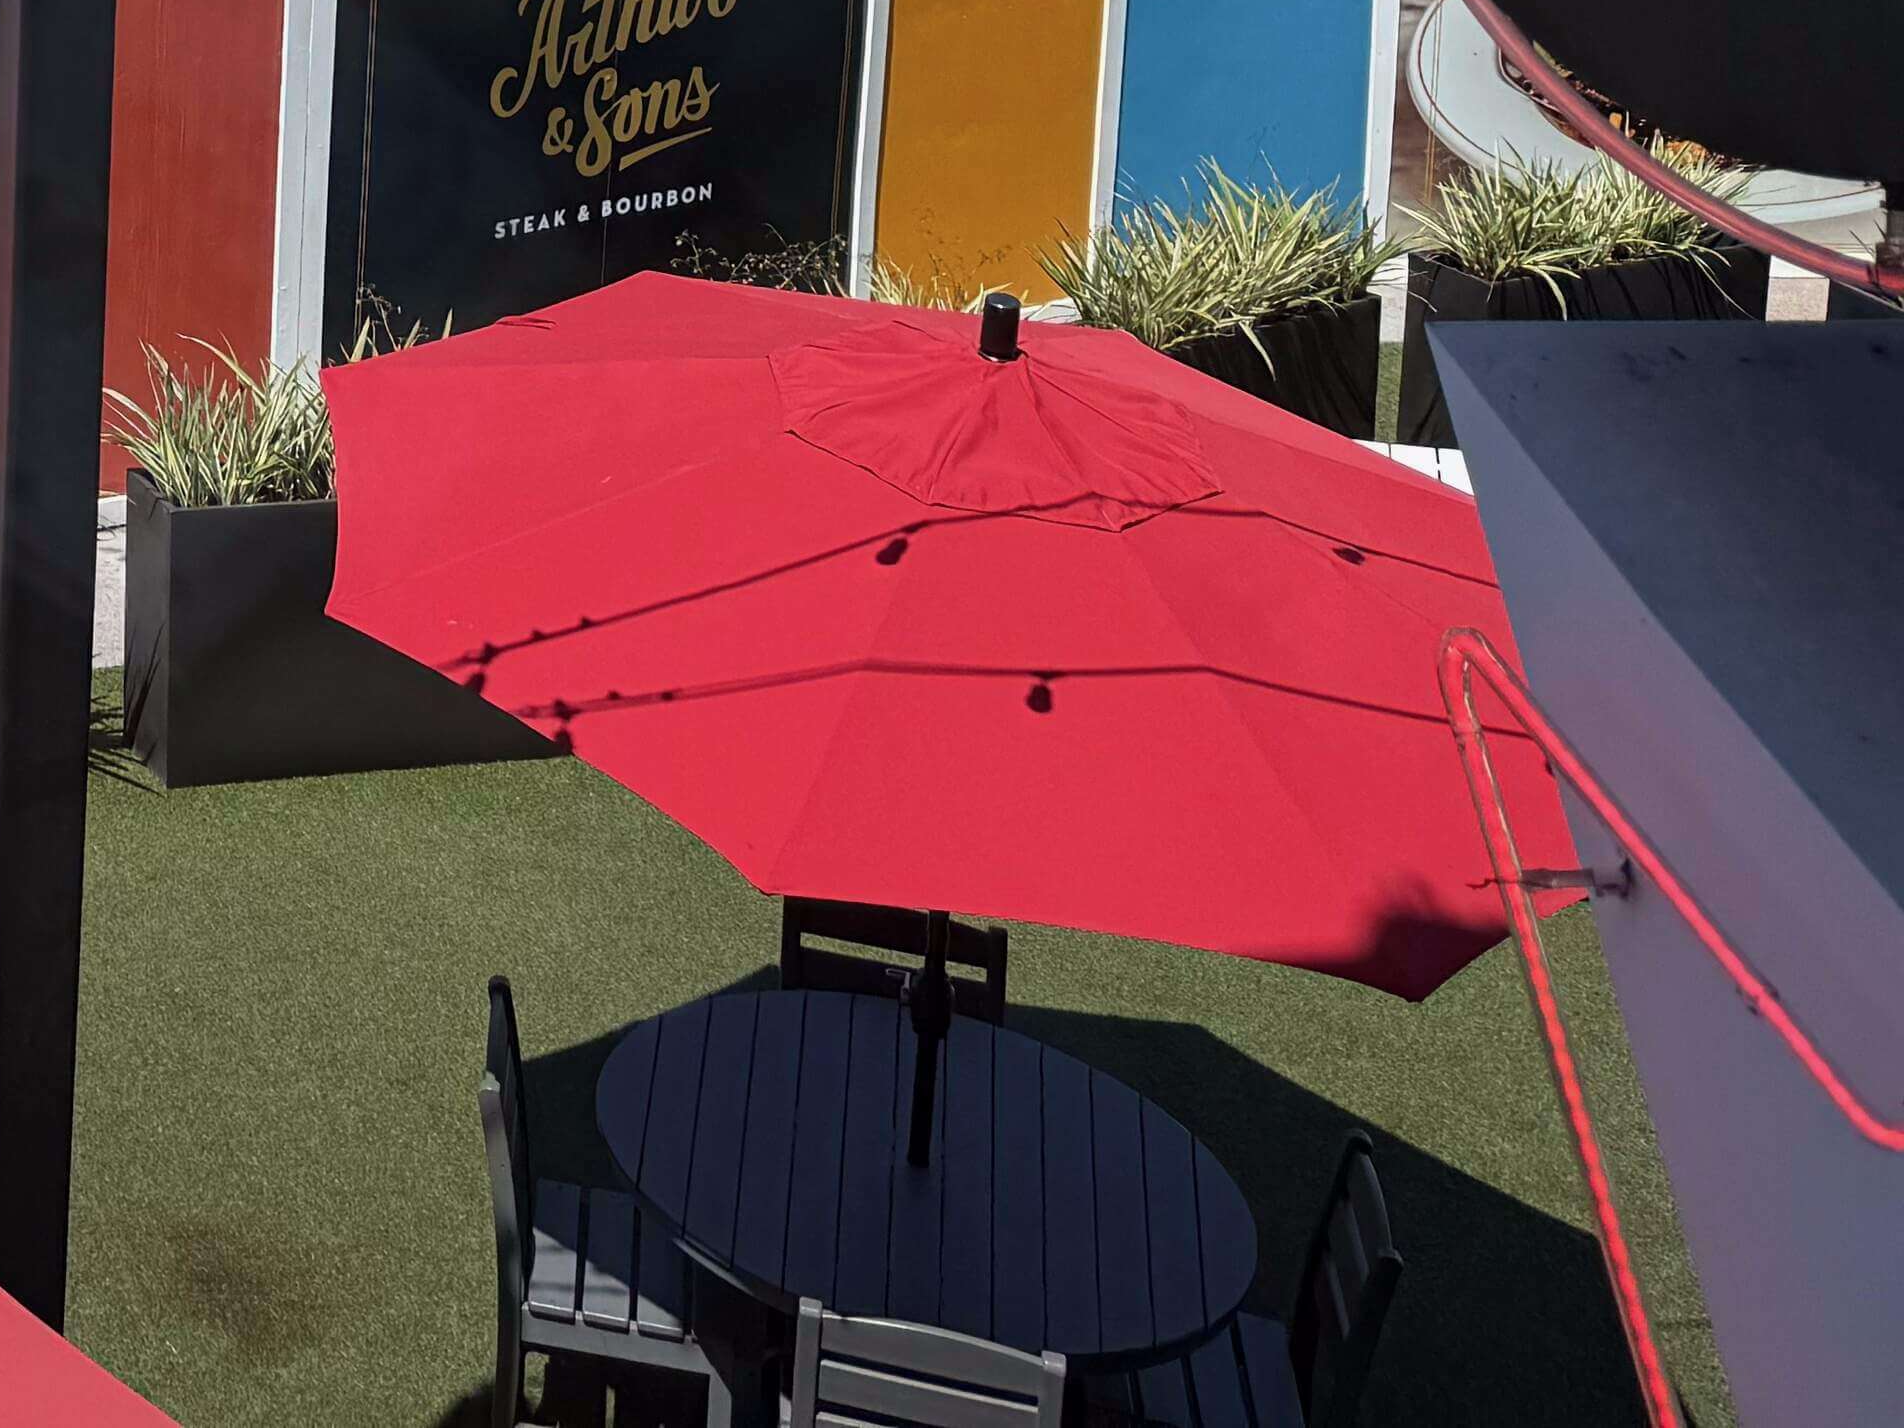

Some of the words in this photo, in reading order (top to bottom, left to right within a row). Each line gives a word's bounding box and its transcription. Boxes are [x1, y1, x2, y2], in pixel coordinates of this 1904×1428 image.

[542, 107, 574, 156] &
[575, 66, 720, 177] Sons
[494, 209, 567, 239] STEAK
[577, 204, 590, 223] &
[601, 182, 713, 218] BOURBON
